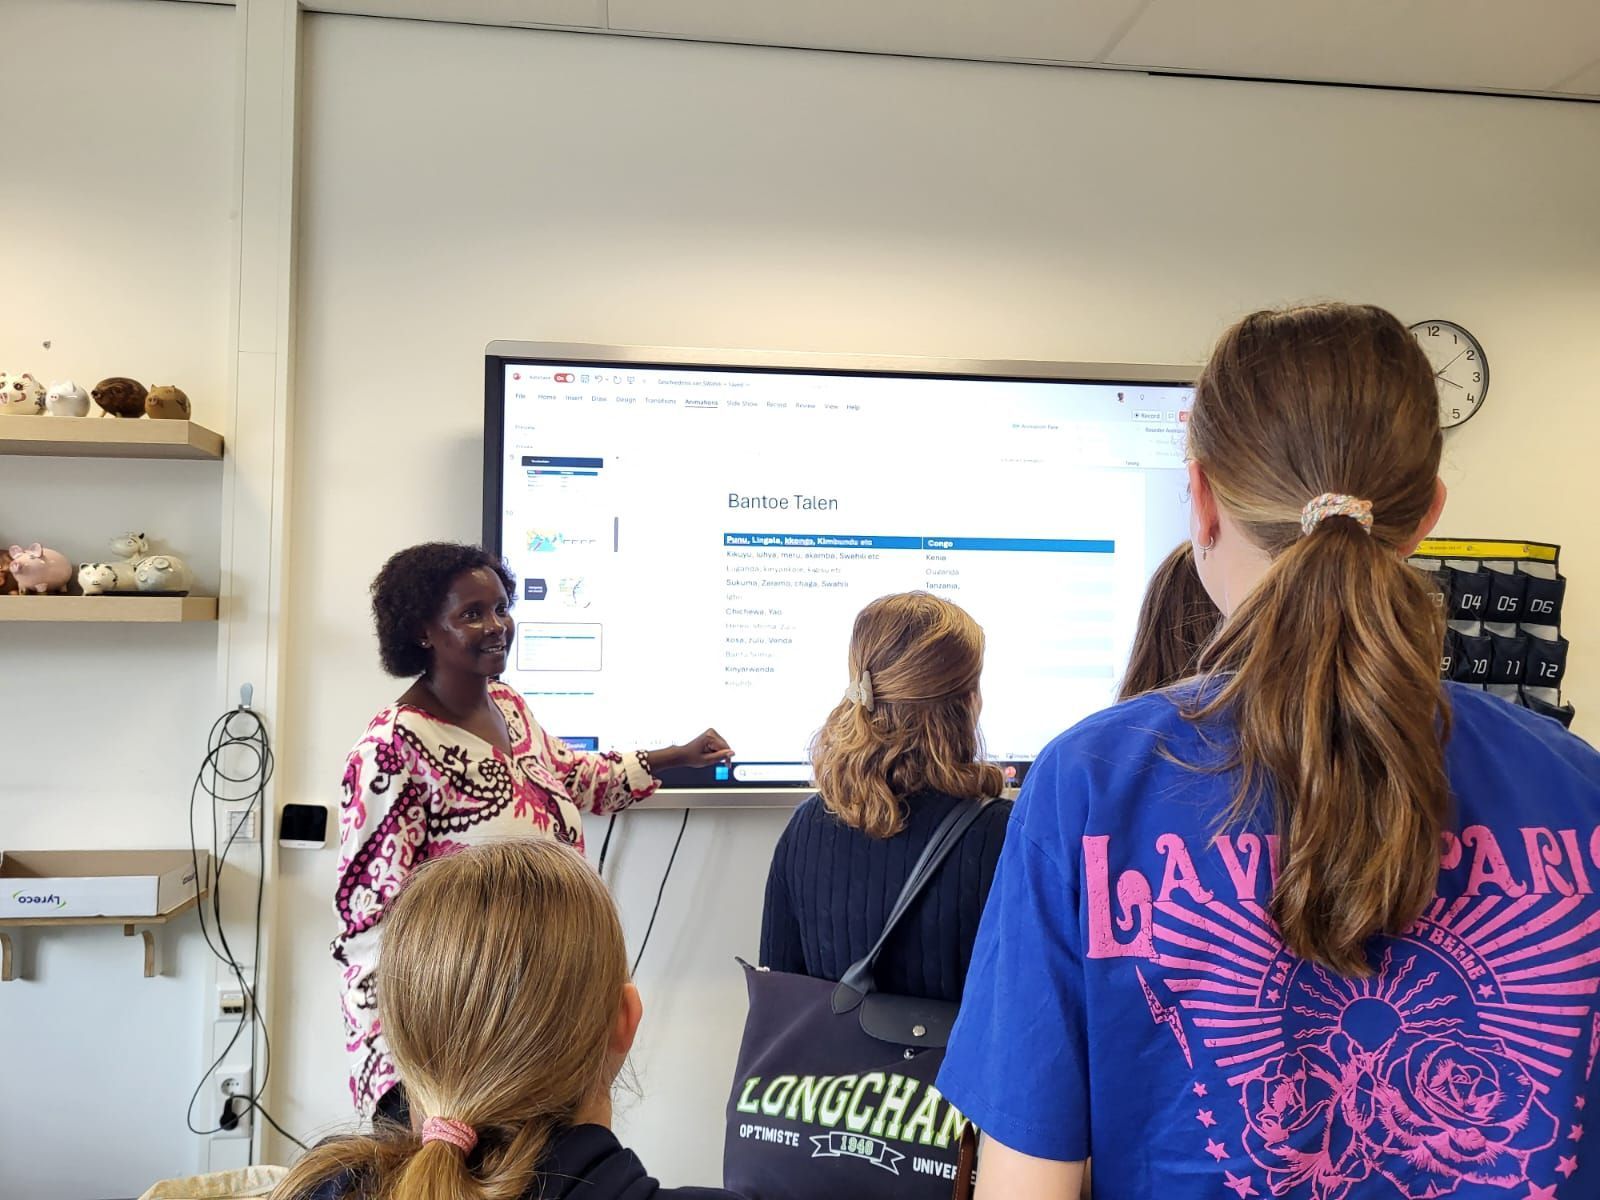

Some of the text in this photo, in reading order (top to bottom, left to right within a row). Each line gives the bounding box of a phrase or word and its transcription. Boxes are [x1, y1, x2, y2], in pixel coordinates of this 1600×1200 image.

[1427, 325, 1440, 337] 12
[1453, 333, 1458, 345] 1
[1466, 349, 1475, 361] 2
[1472, 371, 1481, 383] 3
[616, 396, 636, 404] Design
[645, 397, 677, 405] Transitions
[1466, 392, 1475, 404] 4
[846, 403, 860, 411] Help
[1140, 412, 1161, 420] Record
[1452, 408, 1461, 420] 5
[728, 493, 838, 511] Bantoe Talen
[726, 535, 750, 545] Punu,
[751, 536, 783, 546] Lingala,
[817, 537, 859, 546] Kimbundu
[860, 538, 873, 546] etc
[927, 539, 954, 549] Congo
[1461, 593, 1482, 610] 04
[1497, 595, 1519, 612] 05
[1530, 598, 1555, 614] 06
[1439, 656, 1452, 671] 9
[1472, 659, 1488, 674] 10
[1506, 660, 1521, 675] 11
[1539, 661, 1559, 678] 12
[18, 893, 60, 906] Lyreco
[1082, 833, 1214, 959] LA
[1270, 960, 1292, 986] LA
[1428, 926, 1487, 981] BELLE
[739, 1124, 800, 1147] OPTIMISTE
